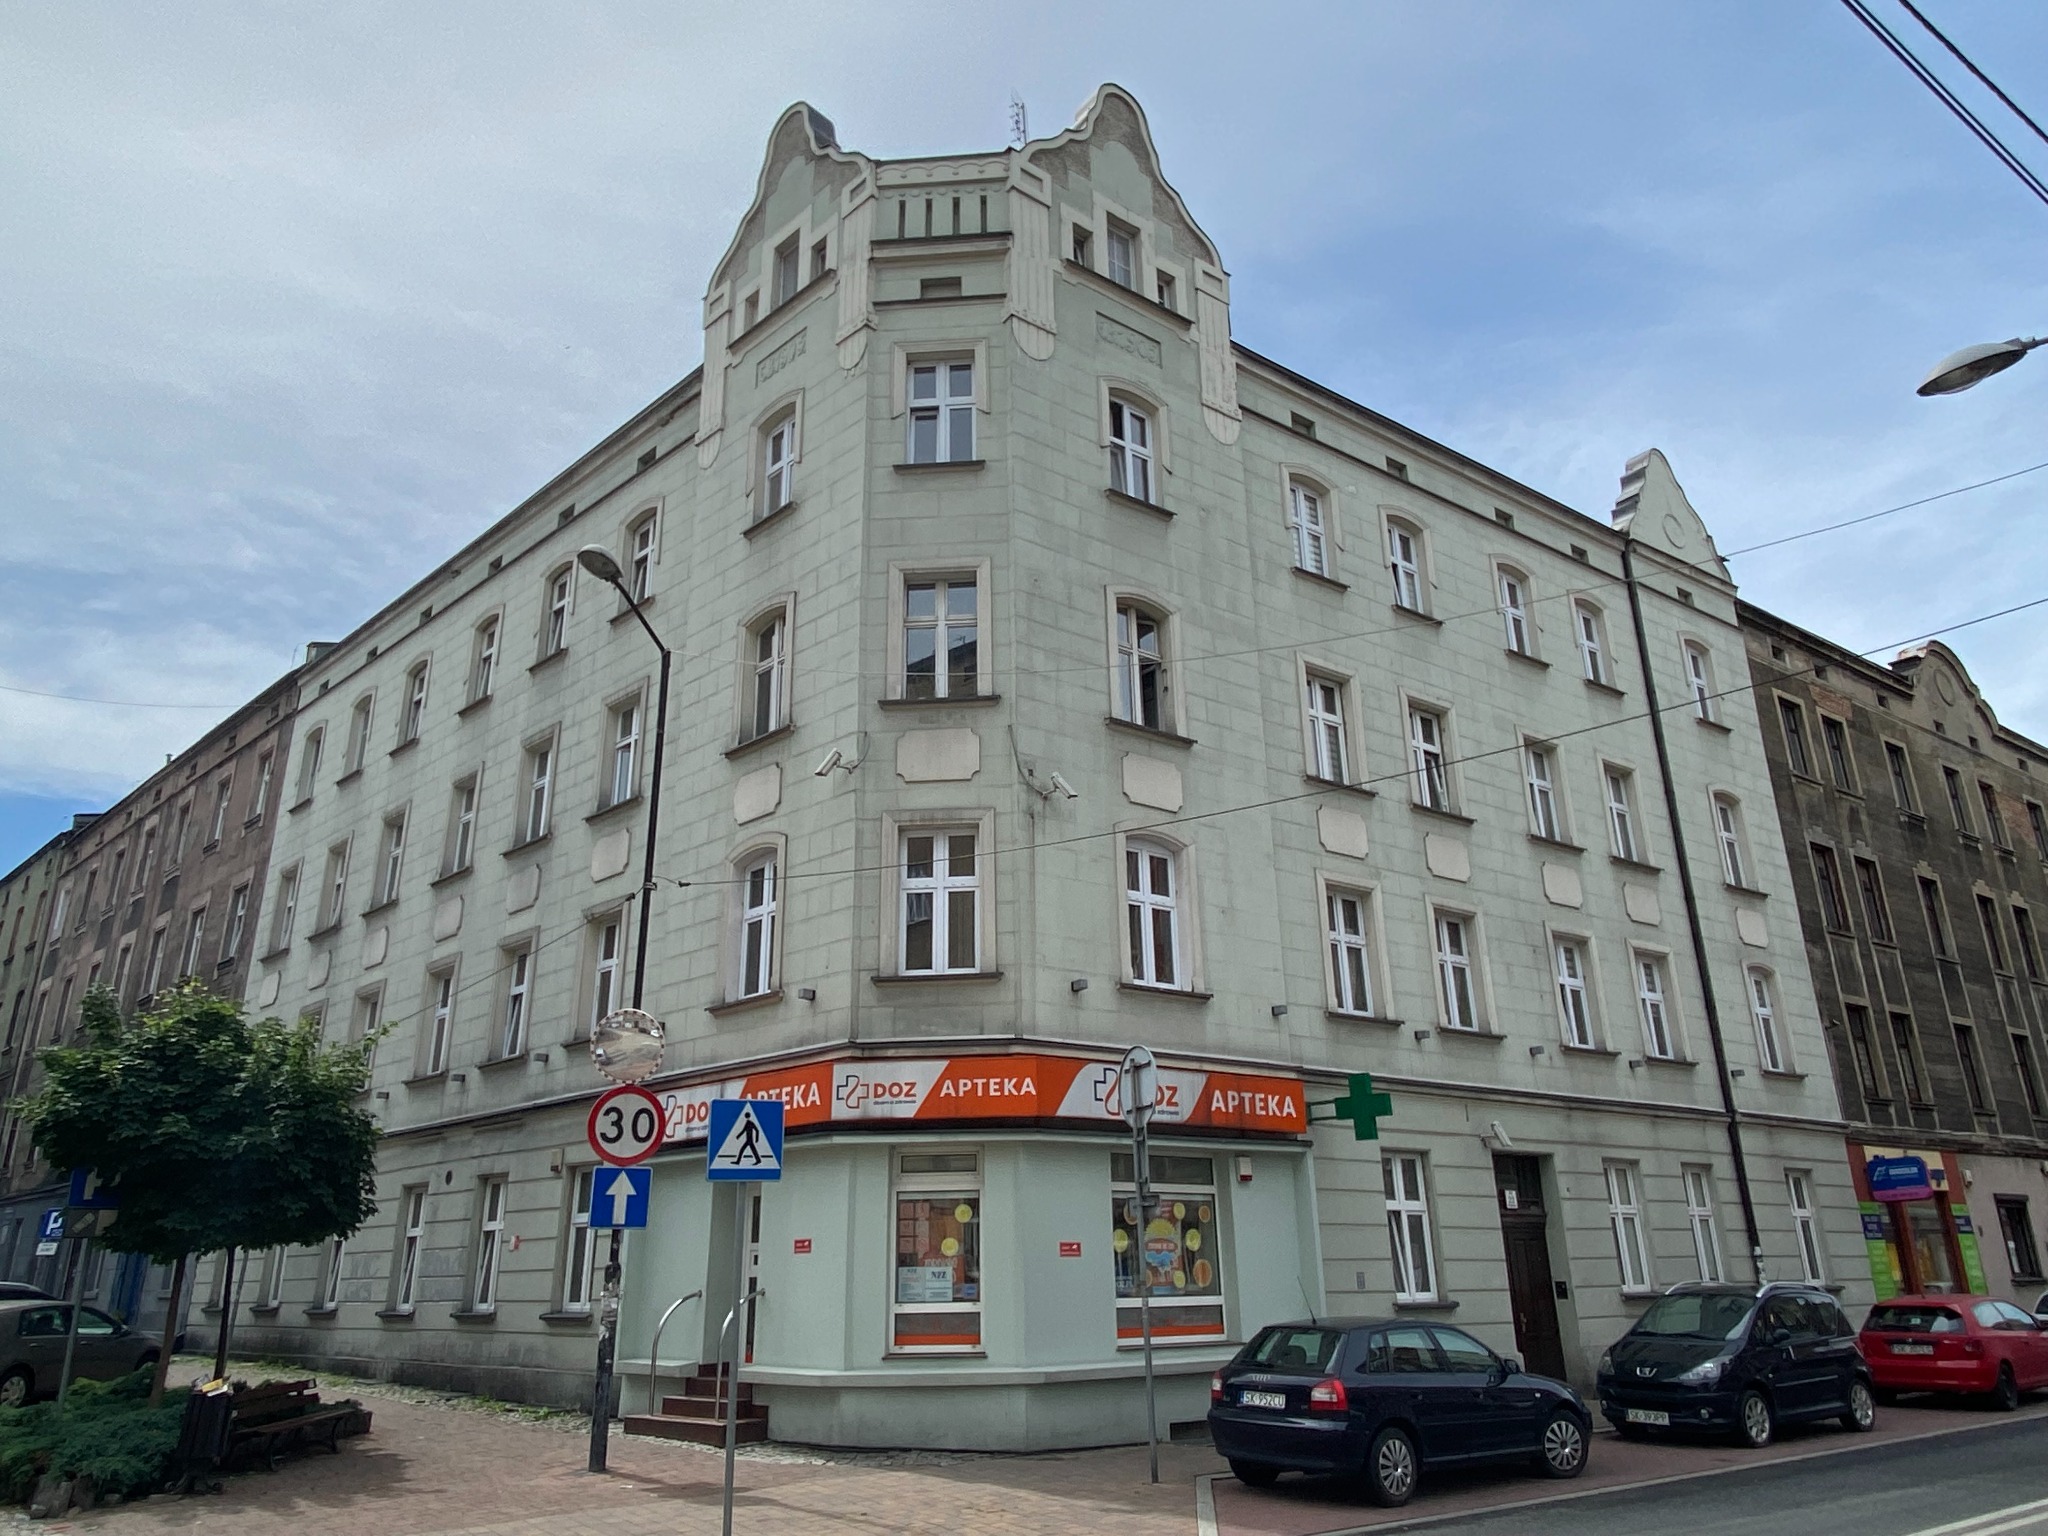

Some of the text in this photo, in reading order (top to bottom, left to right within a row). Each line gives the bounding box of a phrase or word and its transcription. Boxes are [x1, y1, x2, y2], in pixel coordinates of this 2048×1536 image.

[873, 1082, 917, 1099] DOZ
[939, 1077, 1037, 1097] APTEKA
[1155, 1084, 1179, 1107] OZ
[686, 1101, 709, 1123] DO
[1211, 1089, 1297, 1118] APTEKA
[600, 1106, 655, 1144] 30
